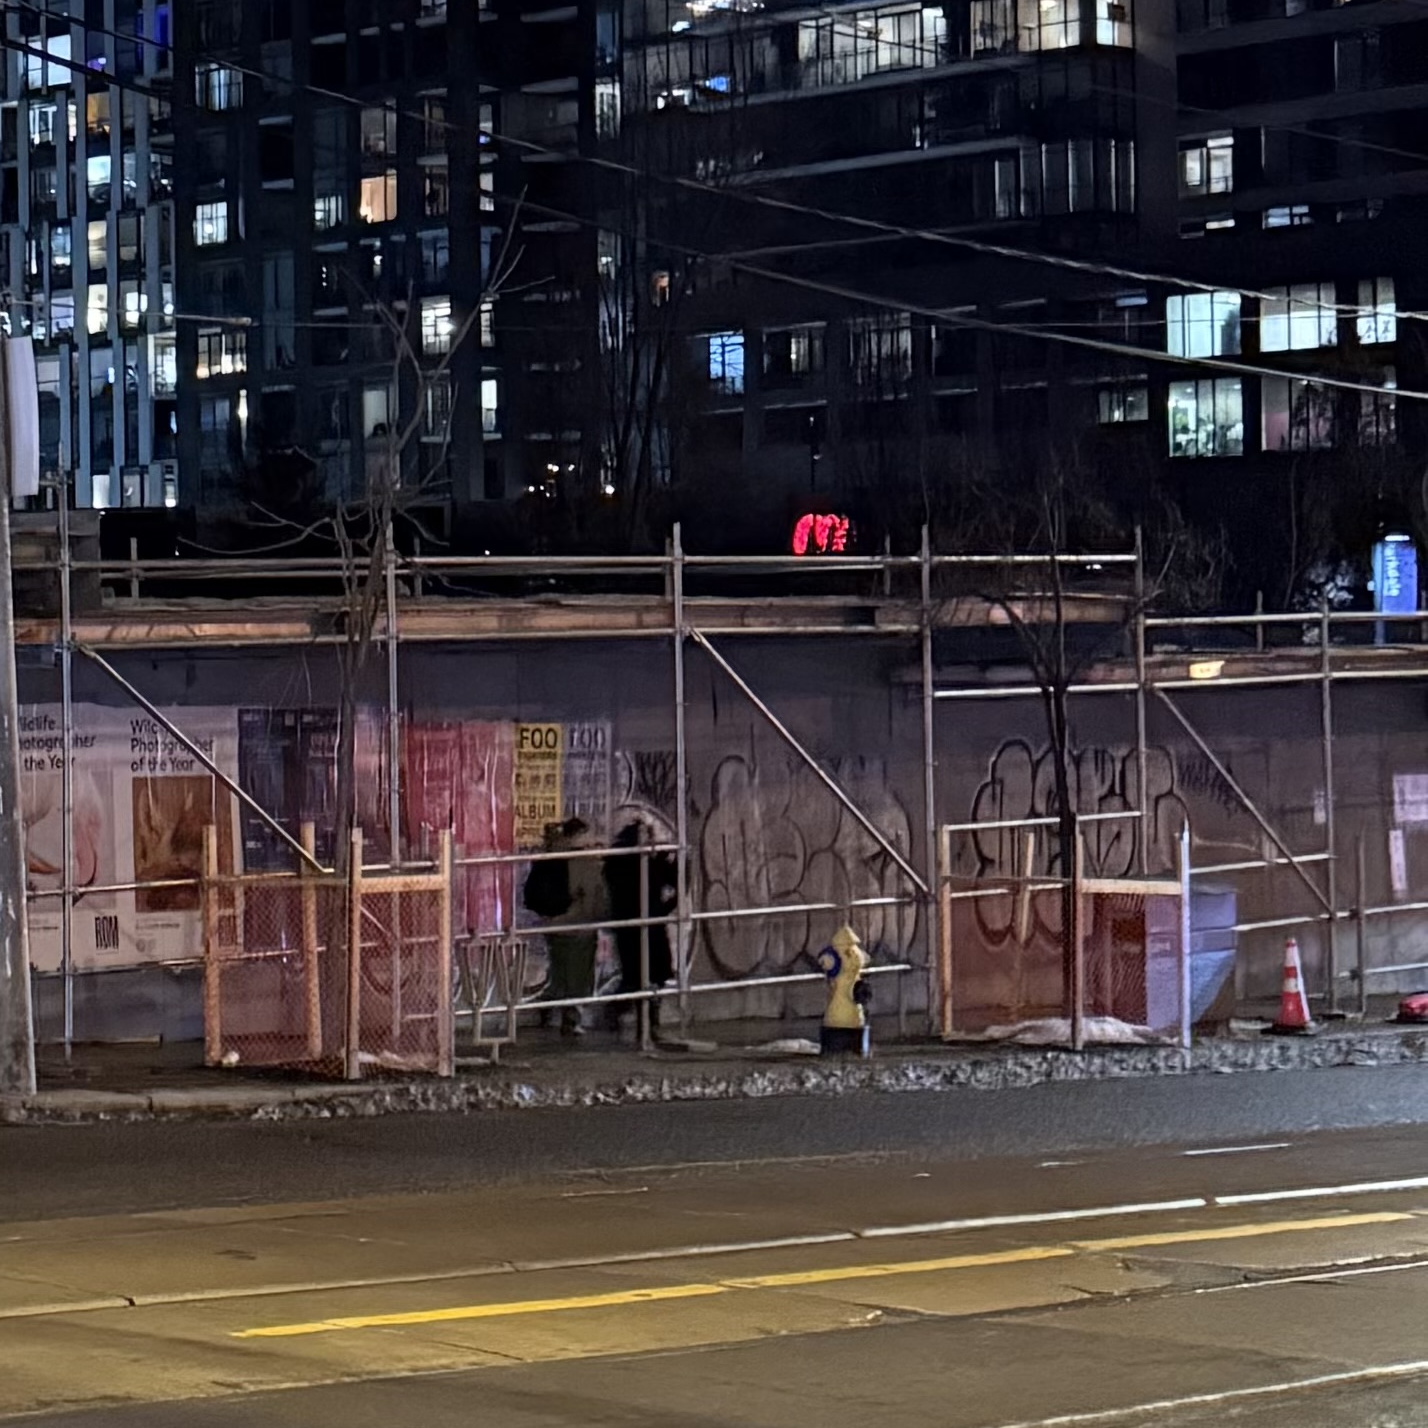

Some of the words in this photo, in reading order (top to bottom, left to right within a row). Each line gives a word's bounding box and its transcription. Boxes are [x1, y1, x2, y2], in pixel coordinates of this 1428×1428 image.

[19, 715, 56, 731] ildlife
[519, 727, 558, 749] FOO
[24, 755, 45, 771] the
[130, 758, 145, 772] of
[169, 757, 196, 772] Year
[514, 803, 556, 820] ALBUM
[95, 915, 120, 950] ROM
